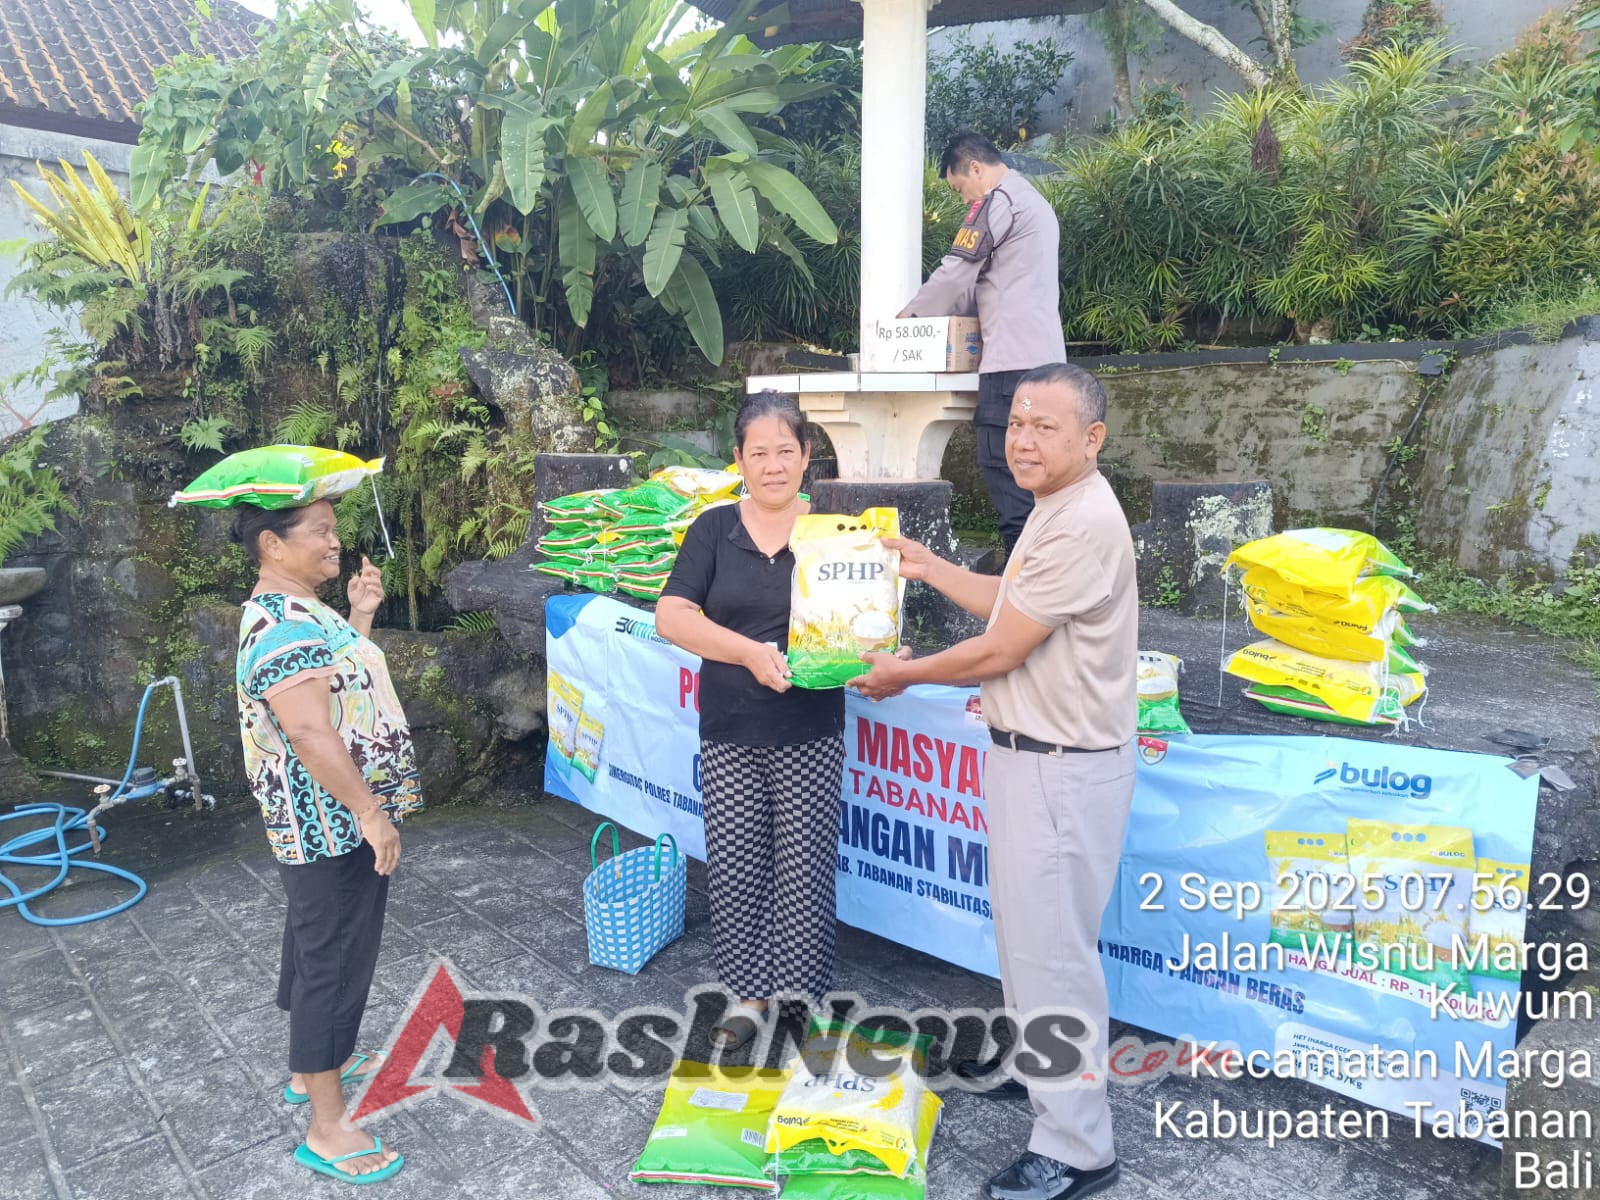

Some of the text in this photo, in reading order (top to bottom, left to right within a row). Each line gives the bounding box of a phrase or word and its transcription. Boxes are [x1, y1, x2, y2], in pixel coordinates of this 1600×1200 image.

[878, 325, 941, 342] Rp 58.000,-
[902, 350, 922, 361] SAK
[818, 562, 884, 581] SPHP
[857, 716, 988, 800] MASYA
[1340, 762, 1432, 799] bulog
[849, 768, 988, 835] TABANAN
[857, 860, 913, 893] TABANAN
[917, 879, 993, 920] STABILITAS
[1107, 943, 1163, 973] HARGA
[1246, 977, 1306, 1014] BERAS
